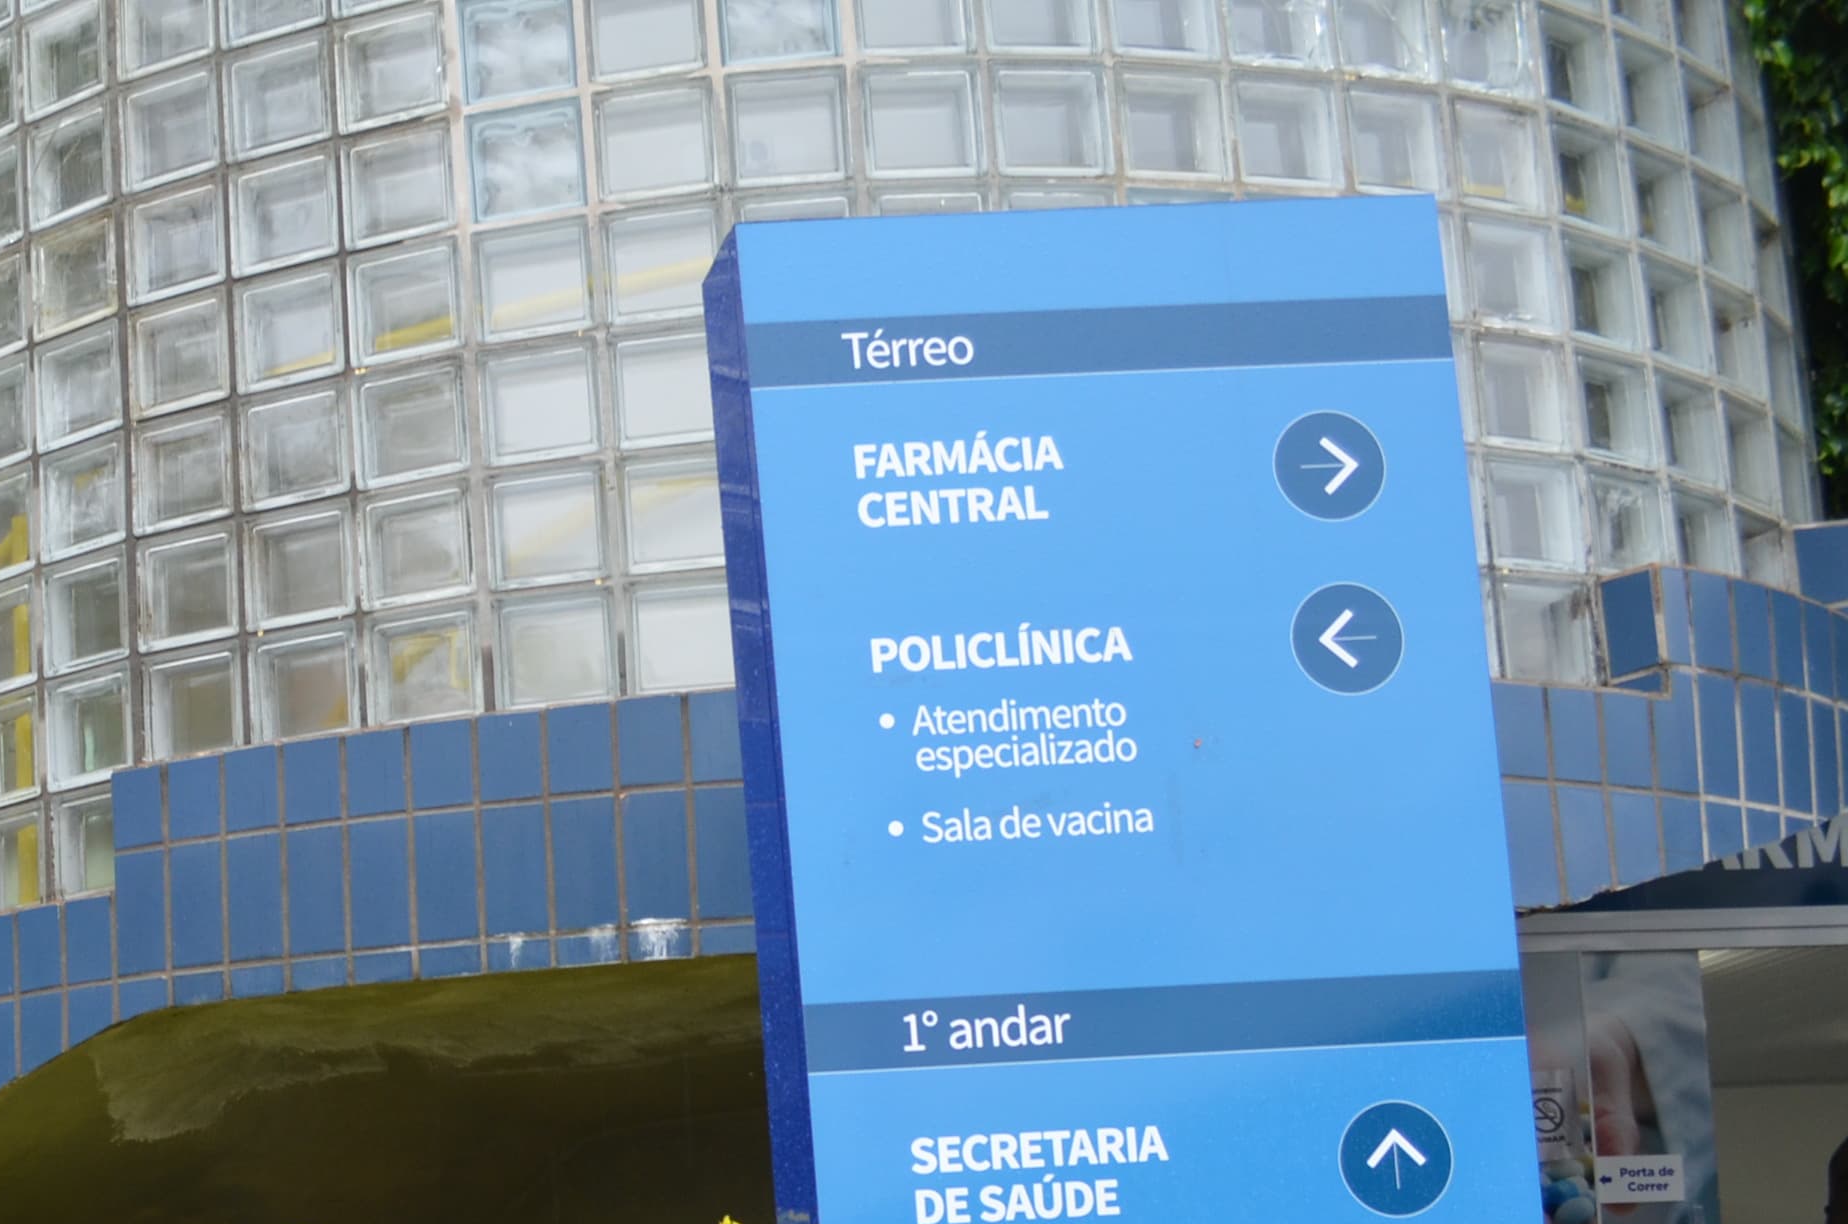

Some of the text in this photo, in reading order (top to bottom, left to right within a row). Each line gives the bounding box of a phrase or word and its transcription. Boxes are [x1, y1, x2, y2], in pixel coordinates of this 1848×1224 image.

[841, 328, 975, 370] Térreo
[853, 431, 1064, 479] FARMÁCIA
[857, 485, 1049, 528] CENTRAL
[870, 623, 1133, 673] POLICLÍNICA
[912, 698, 1127, 737] Atendimento
[915, 731, 1138, 778] especializado
[922, 802, 1153, 844] Sala de vacina
[949, 1003, 1072, 1051] andar
[910, 1126, 1170, 1174] SECRETARIA
[1619, 1166, 1675, 1178] Porta de
[979, 1174, 1121, 1222] SAÚDE
